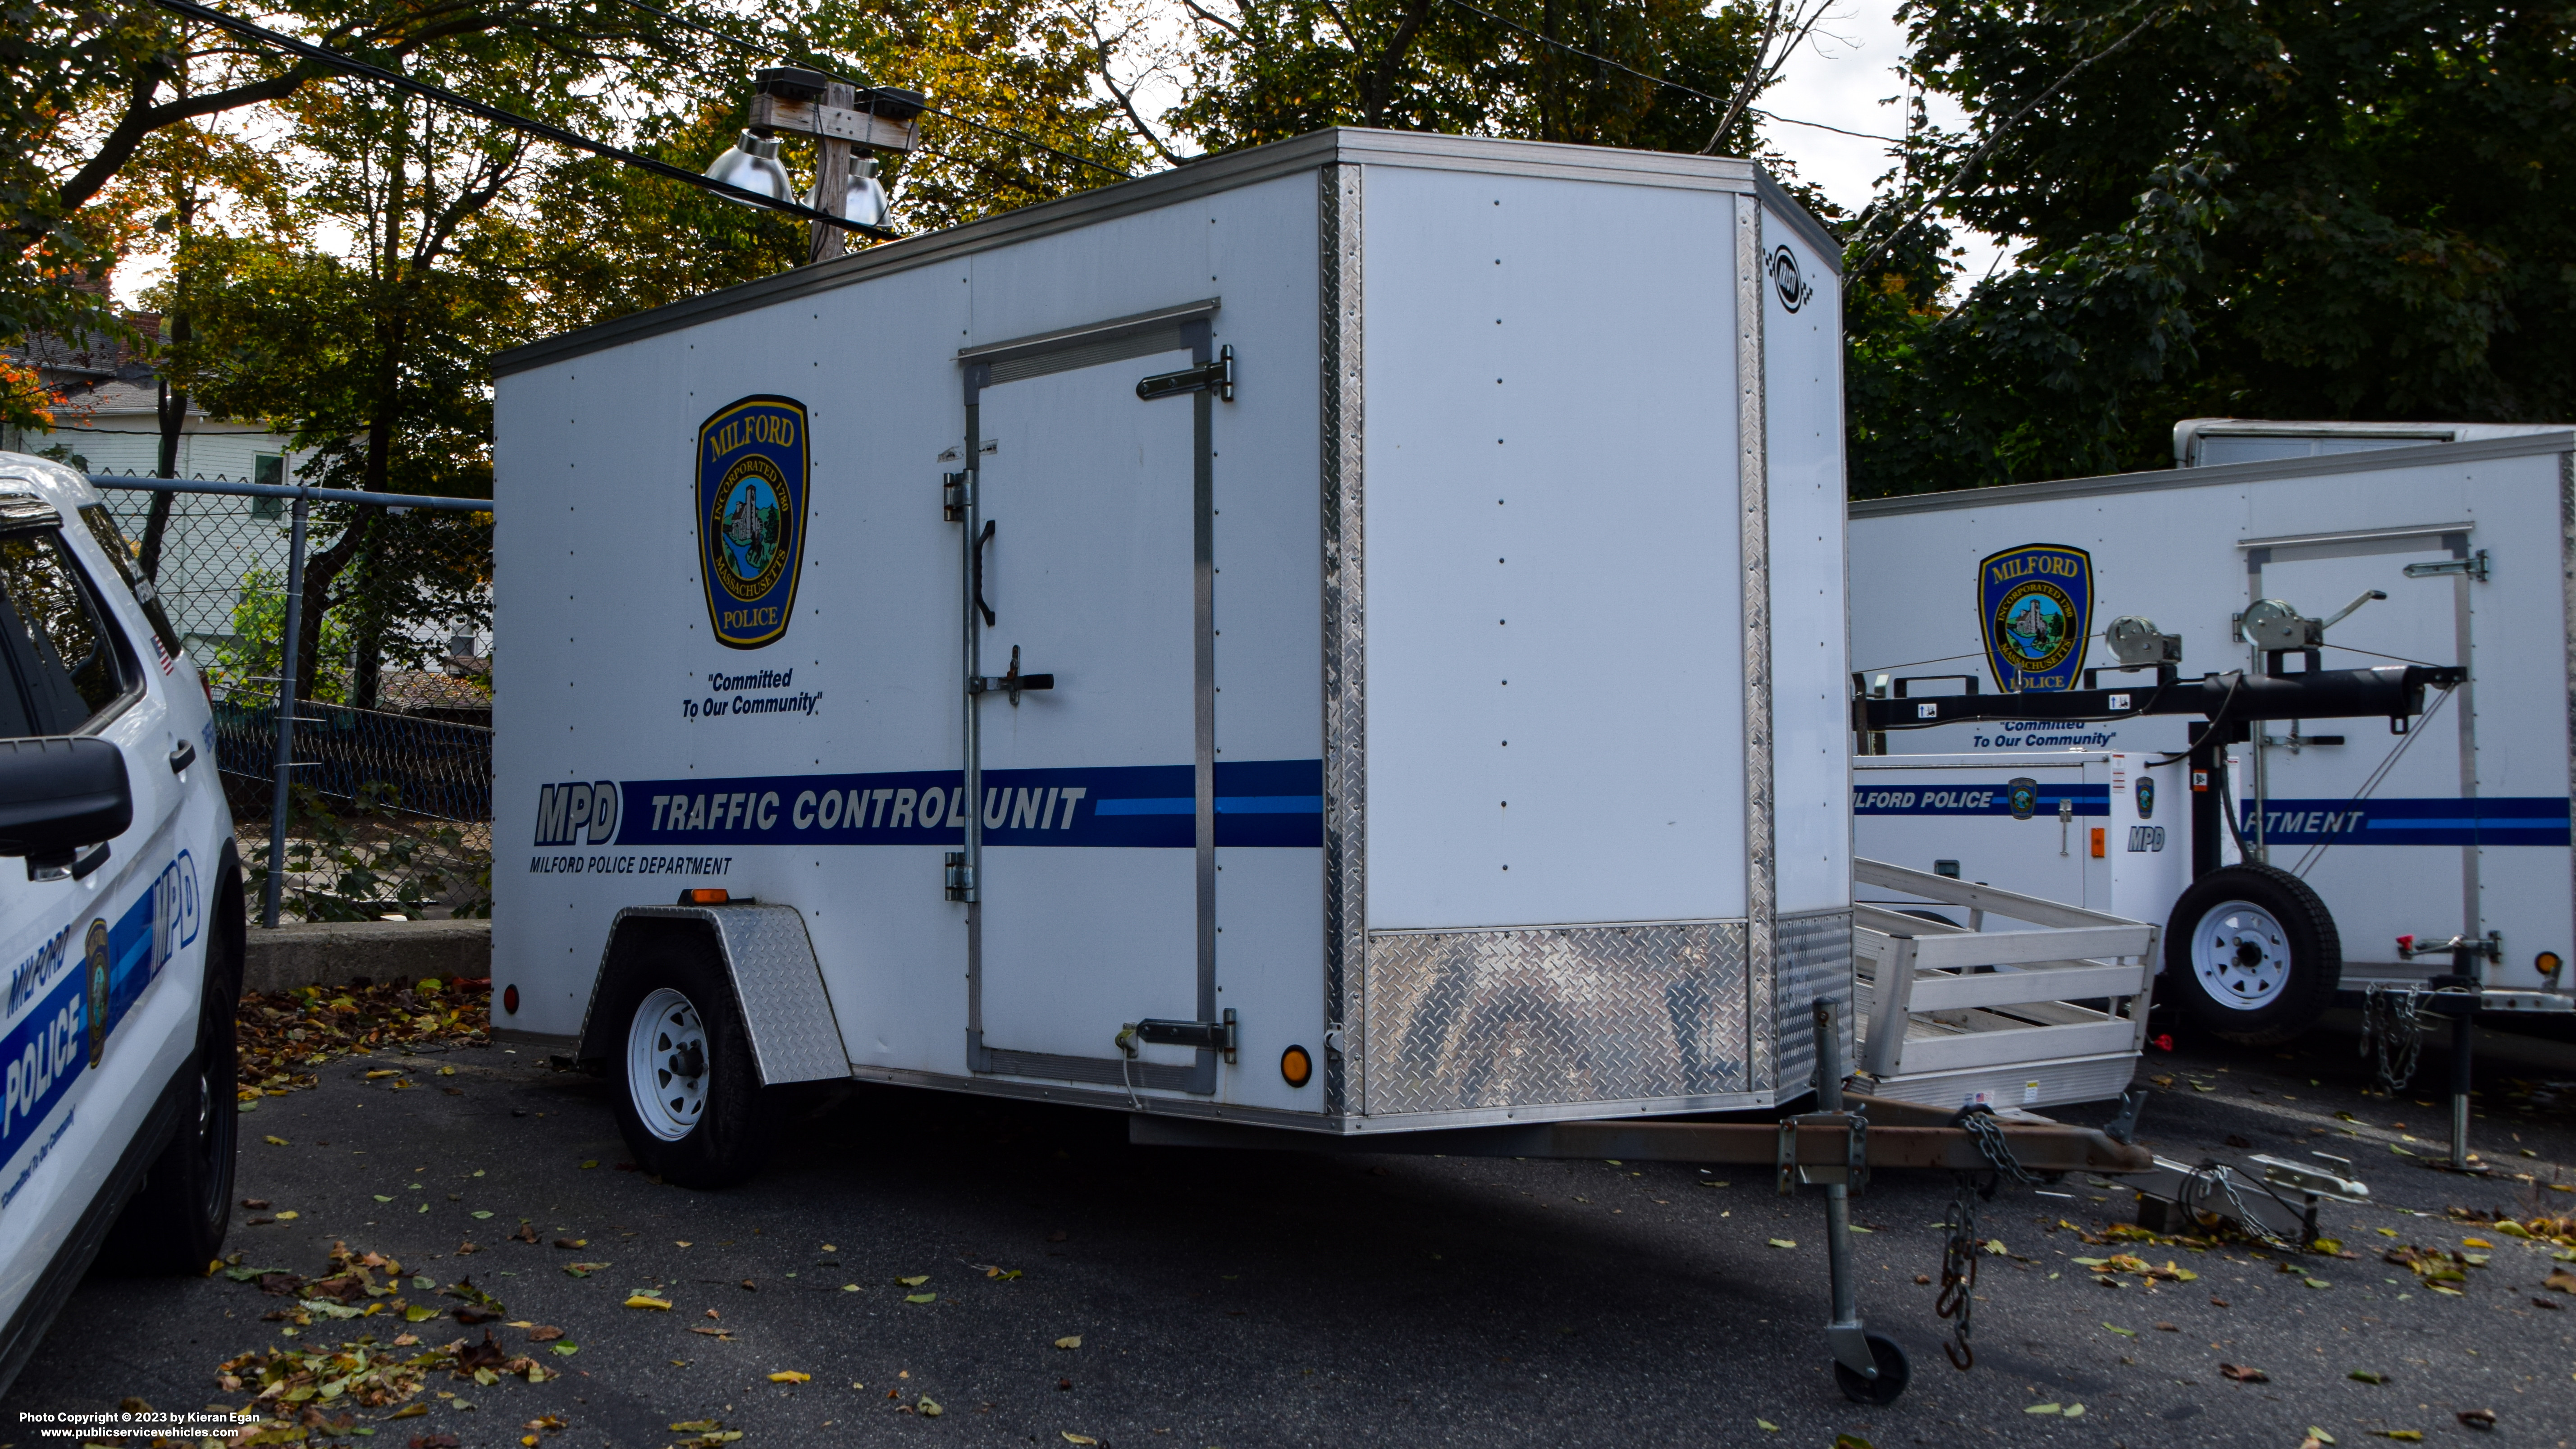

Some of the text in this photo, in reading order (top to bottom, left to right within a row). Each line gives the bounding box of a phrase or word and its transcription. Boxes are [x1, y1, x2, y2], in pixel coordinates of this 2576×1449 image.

[710, 415, 795, 462] MILFORD
[714, 460, 789, 521] INCORPORATED 1780
[716, 549, 786, 597] MASSACHUSETTS
[1992, 556, 2078, 584] MILFORD
[724, 607, 778, 629] POLICE
[1998, 584, 2073, 621] INCORPORATED 1780
[2000, 640, 2071, 669] MASSACHUSETTS
[708, 668, 793, 691] "Committed
[683, 691, 823, 718] To Our Community"
[1973, 732, 2116, 748] To Our Community"
[534, 780, 618, 847] MPD
[652, 787, 1087, 830] TRAFFIC CONTROL UNIT
[1920, 791, 1994, 808] POLICE
[2127, 826, 2165, 852] MPD
[530, 857, 732, 875] MILFORD POLICE DEPARTMENT
[150, 848, 200, 983] MPD
[7, 923, 71, 1019] MILFORD
[3, 992, 80, 1139] POLICE
